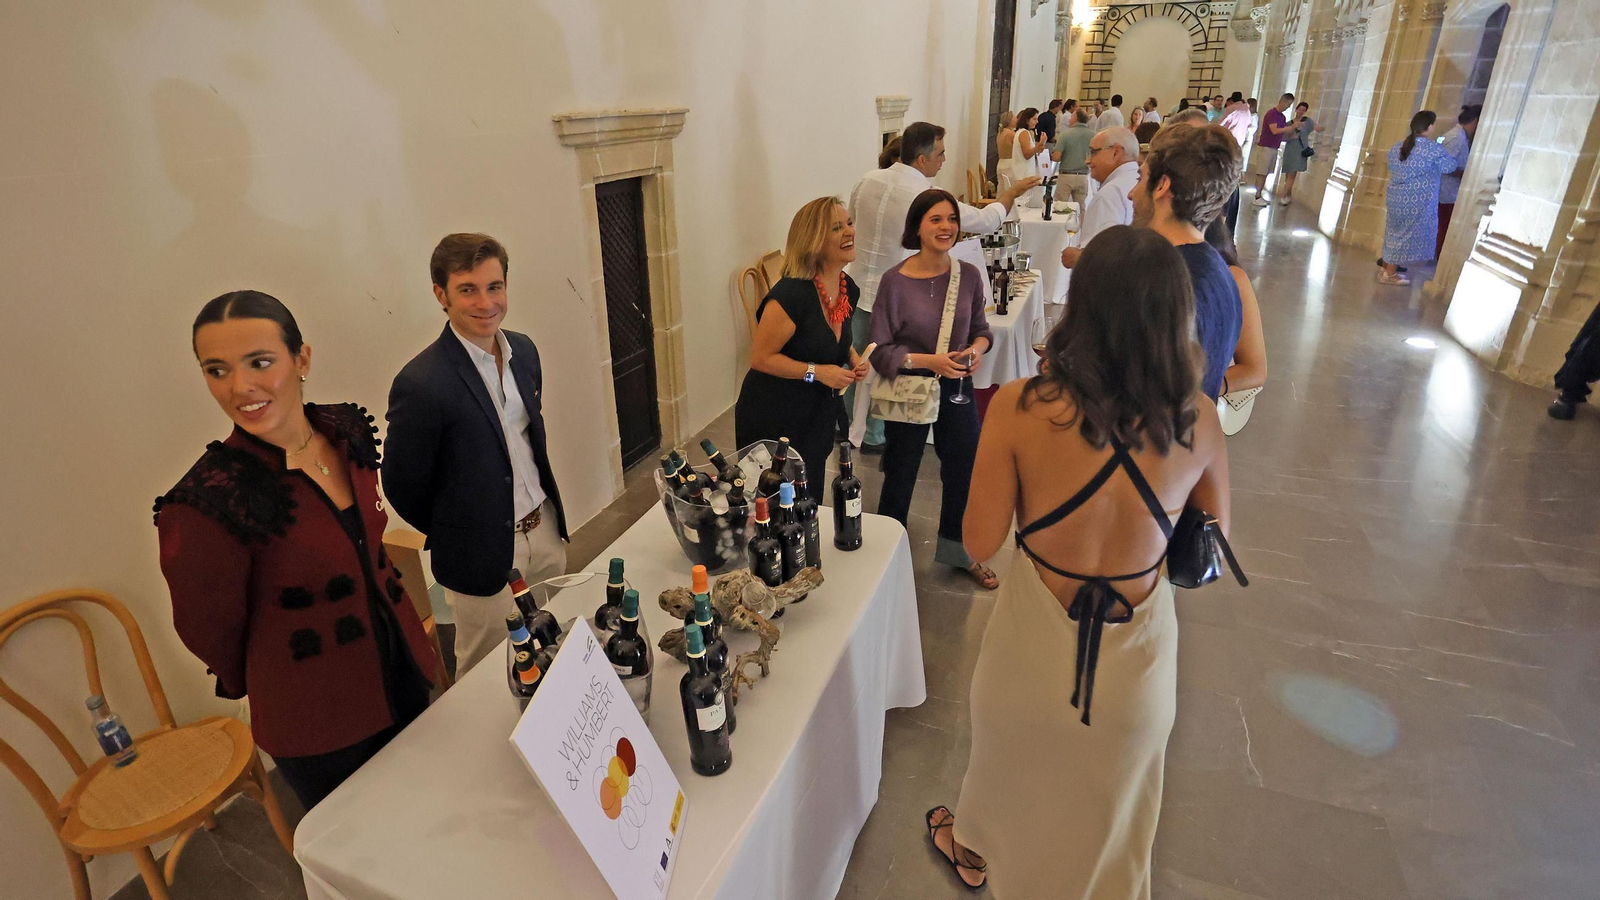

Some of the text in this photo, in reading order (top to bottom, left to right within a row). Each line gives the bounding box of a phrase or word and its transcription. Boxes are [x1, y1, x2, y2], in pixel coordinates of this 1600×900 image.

[558, 675, 603, 761] WILLIAMS
[566, 681, 615, 791] & HUMBERT
